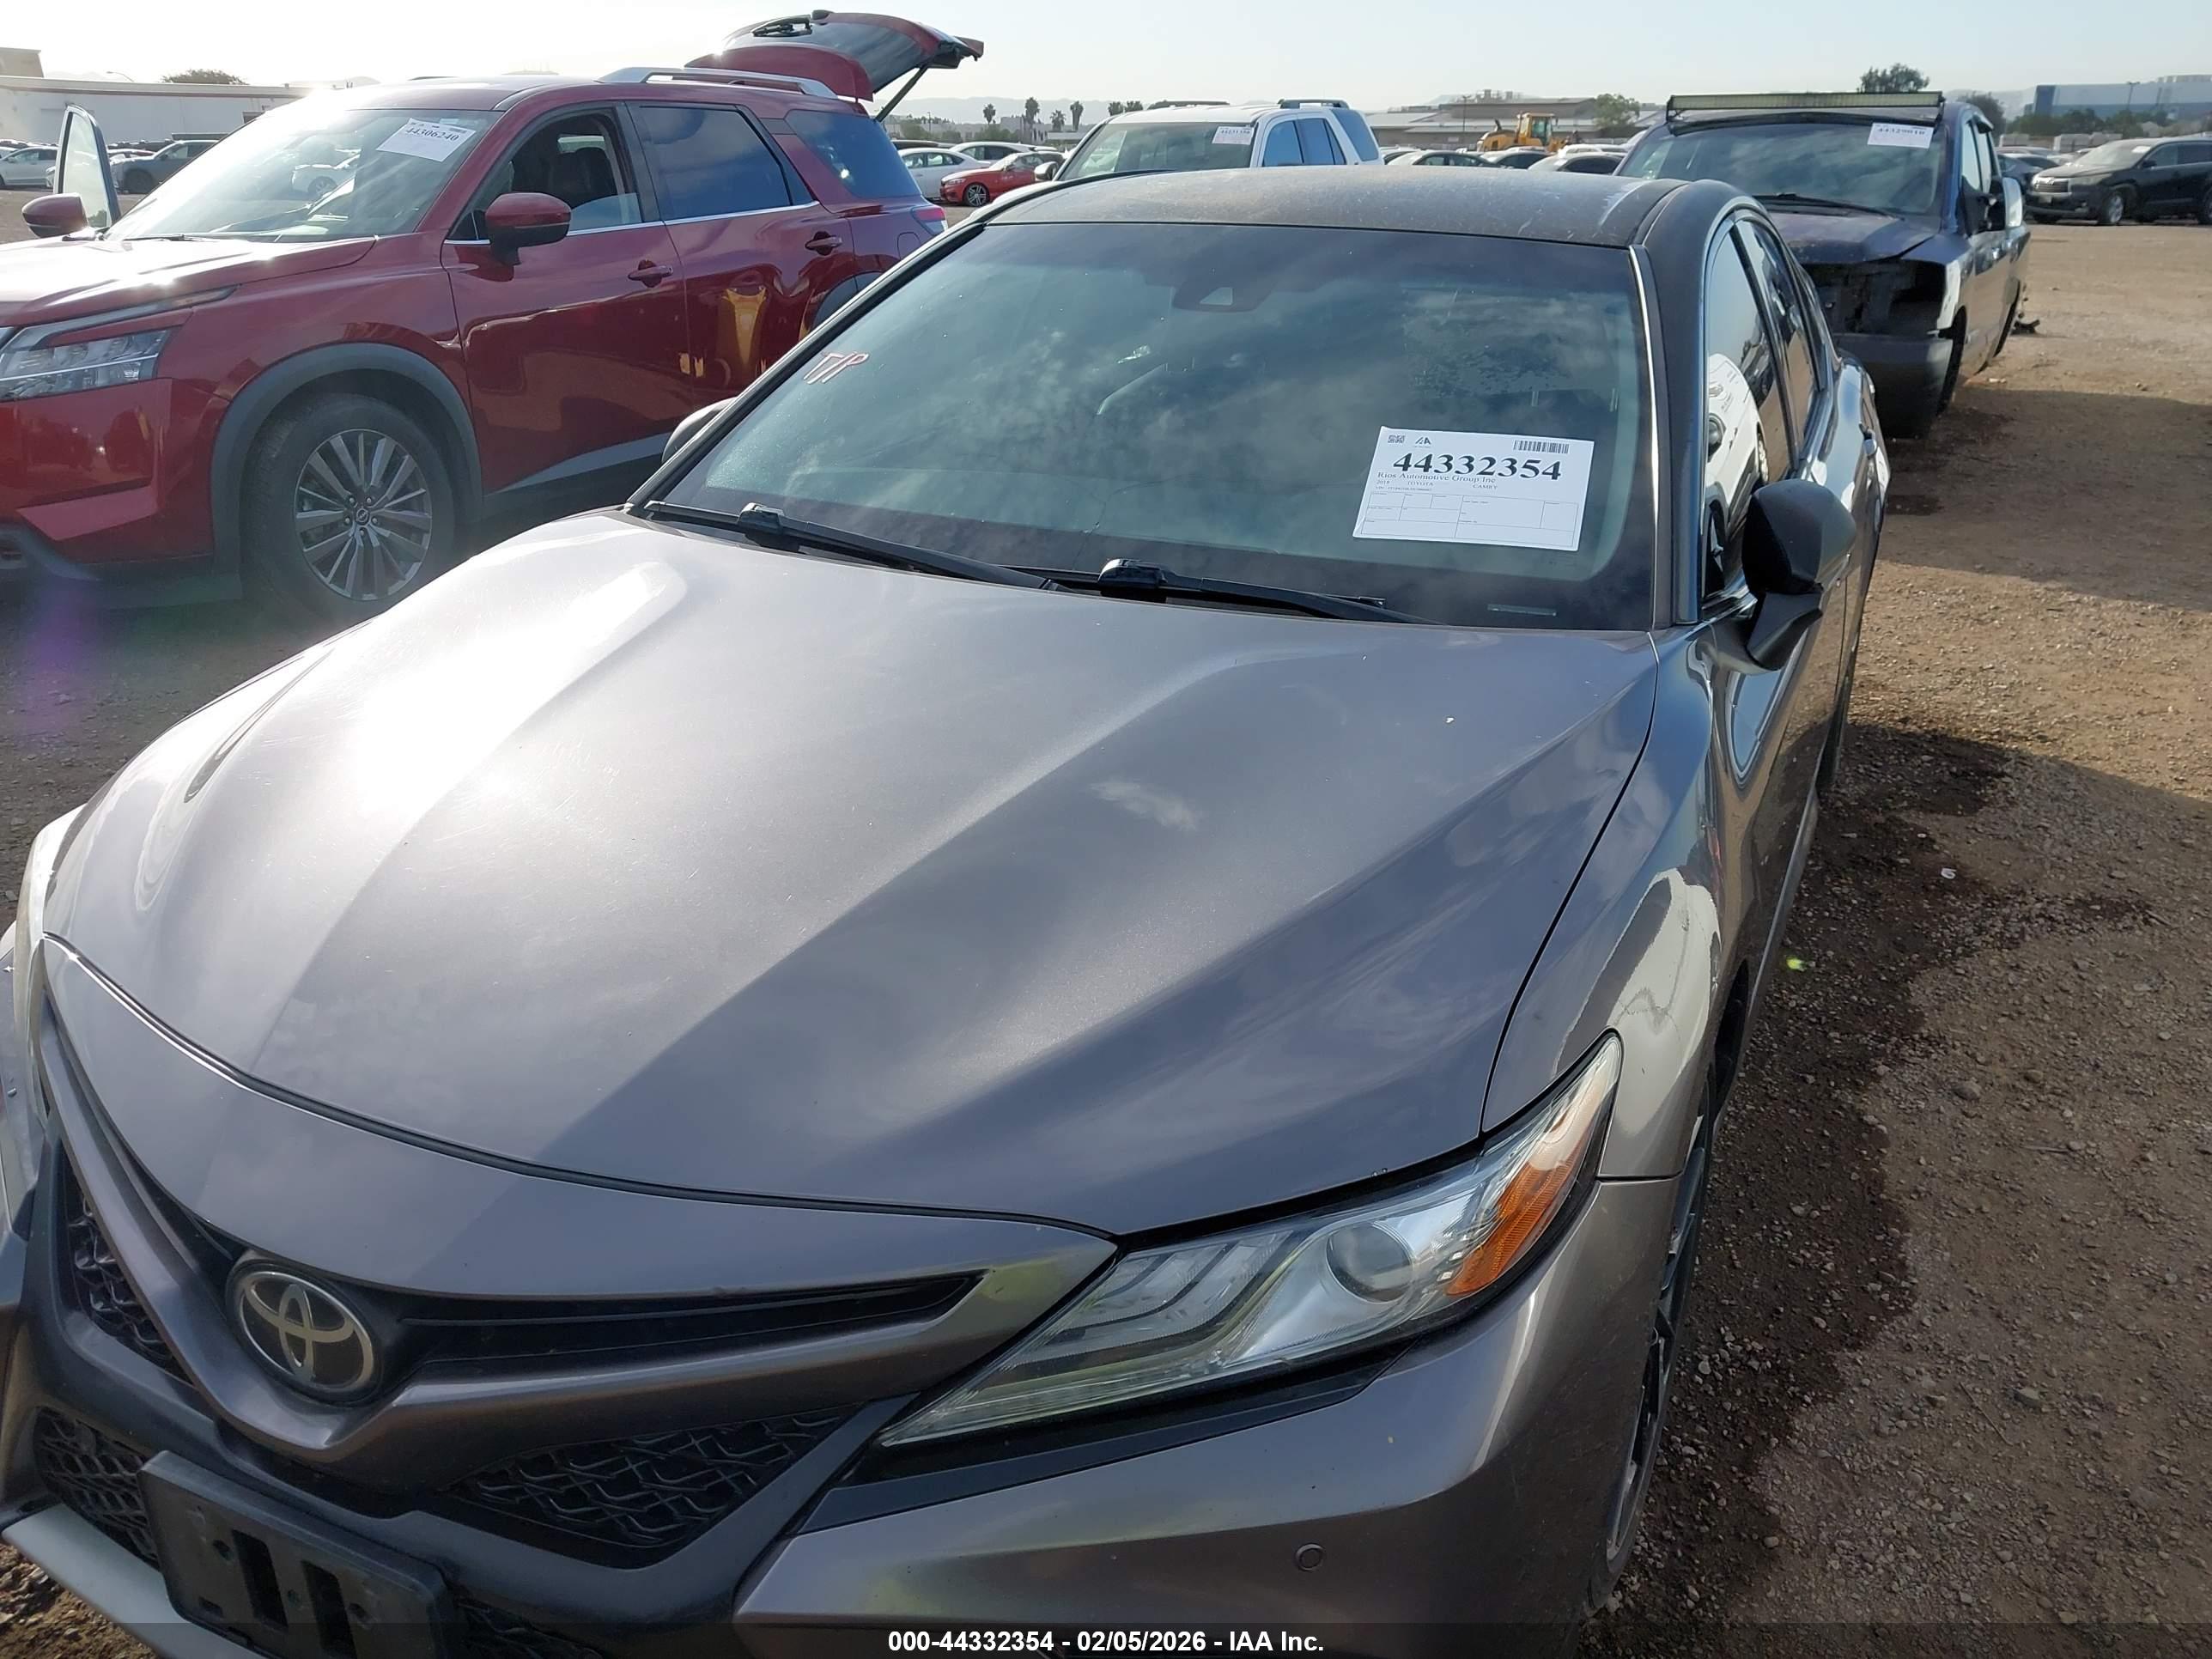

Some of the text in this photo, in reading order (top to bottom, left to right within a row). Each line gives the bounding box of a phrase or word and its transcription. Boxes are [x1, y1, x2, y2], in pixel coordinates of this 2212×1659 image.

[1393, 453, 1562, 481] 44332354
[1400, 472, 1449, 481] Automotive
[1452, 474, 1480, 483] Group
